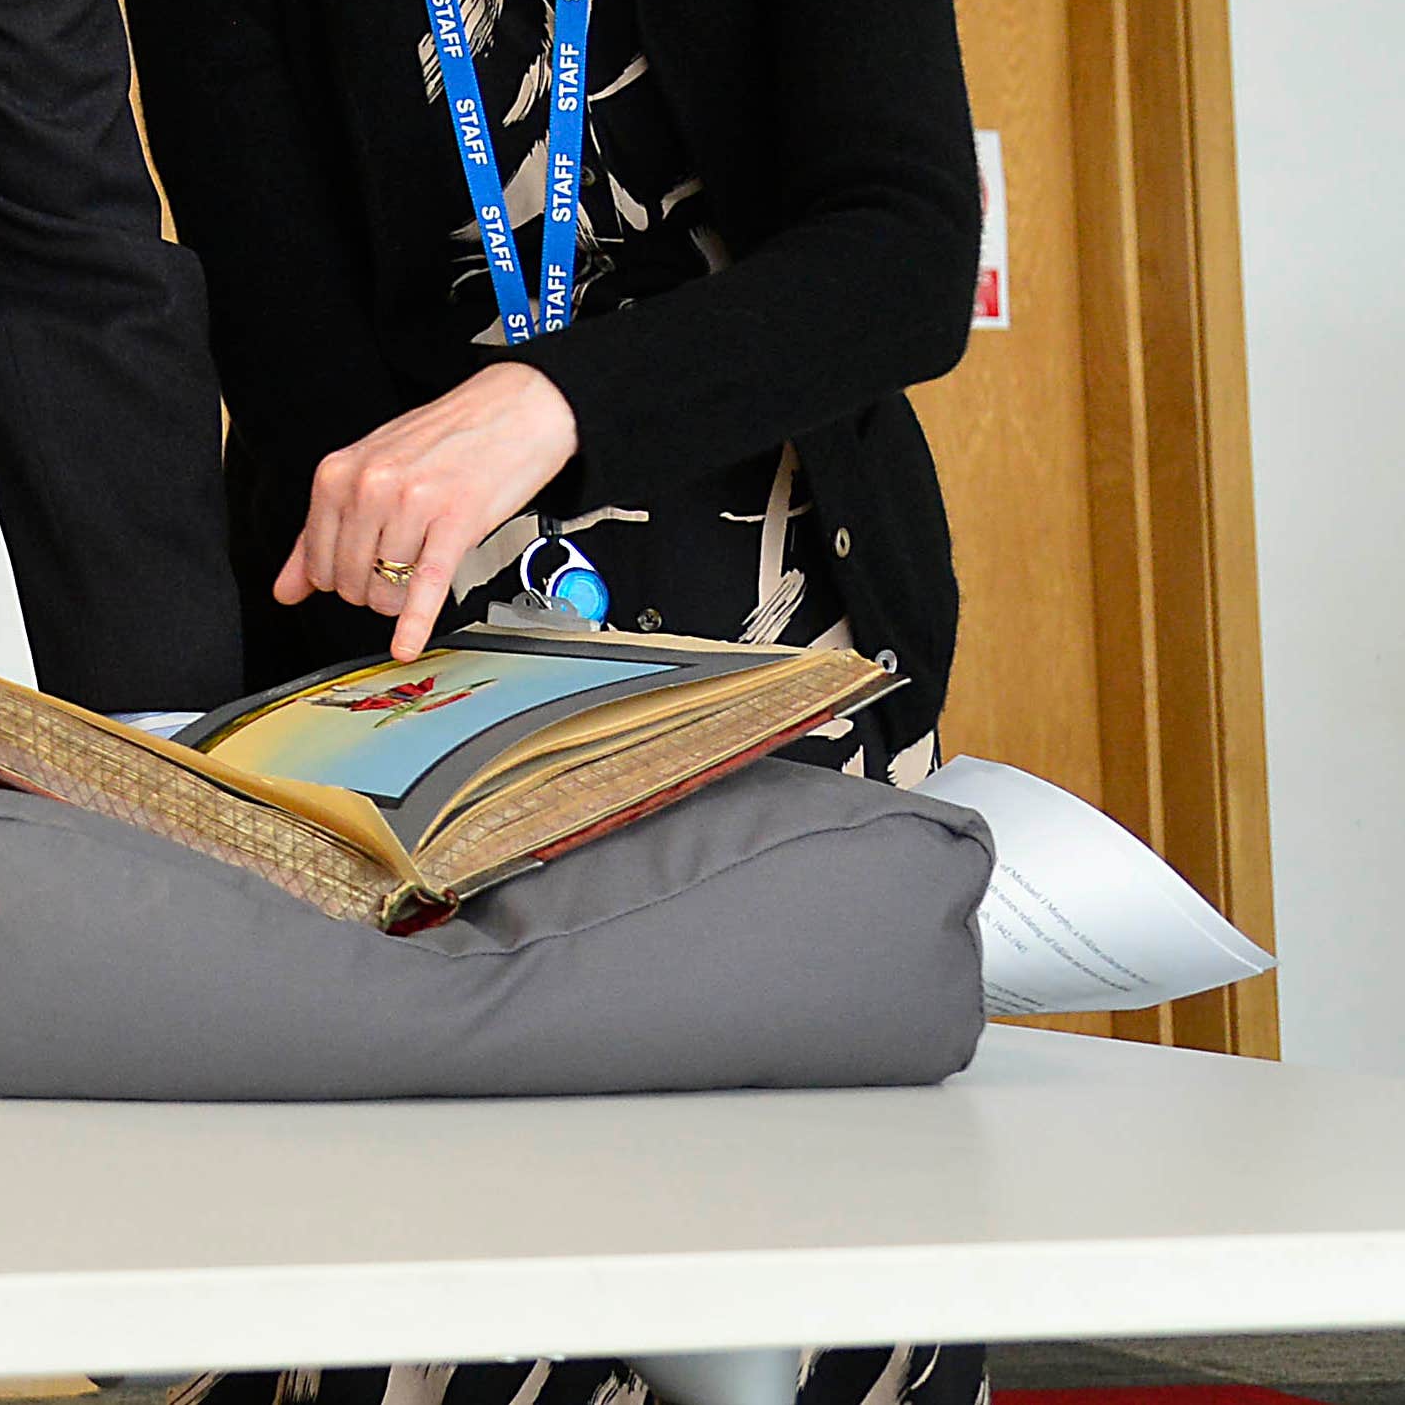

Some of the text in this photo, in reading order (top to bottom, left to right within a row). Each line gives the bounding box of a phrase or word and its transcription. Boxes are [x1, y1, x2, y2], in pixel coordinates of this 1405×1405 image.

[558, 42, 579, 112] STAFF
[456, 98, 487, 165] STAFF
[481, 205, 514, 273] STAFF
[552, 153, 574, 222] STAFF
[545, 264, 567, 332] STAFF
[1011, 869, 1041, 900] Michael
